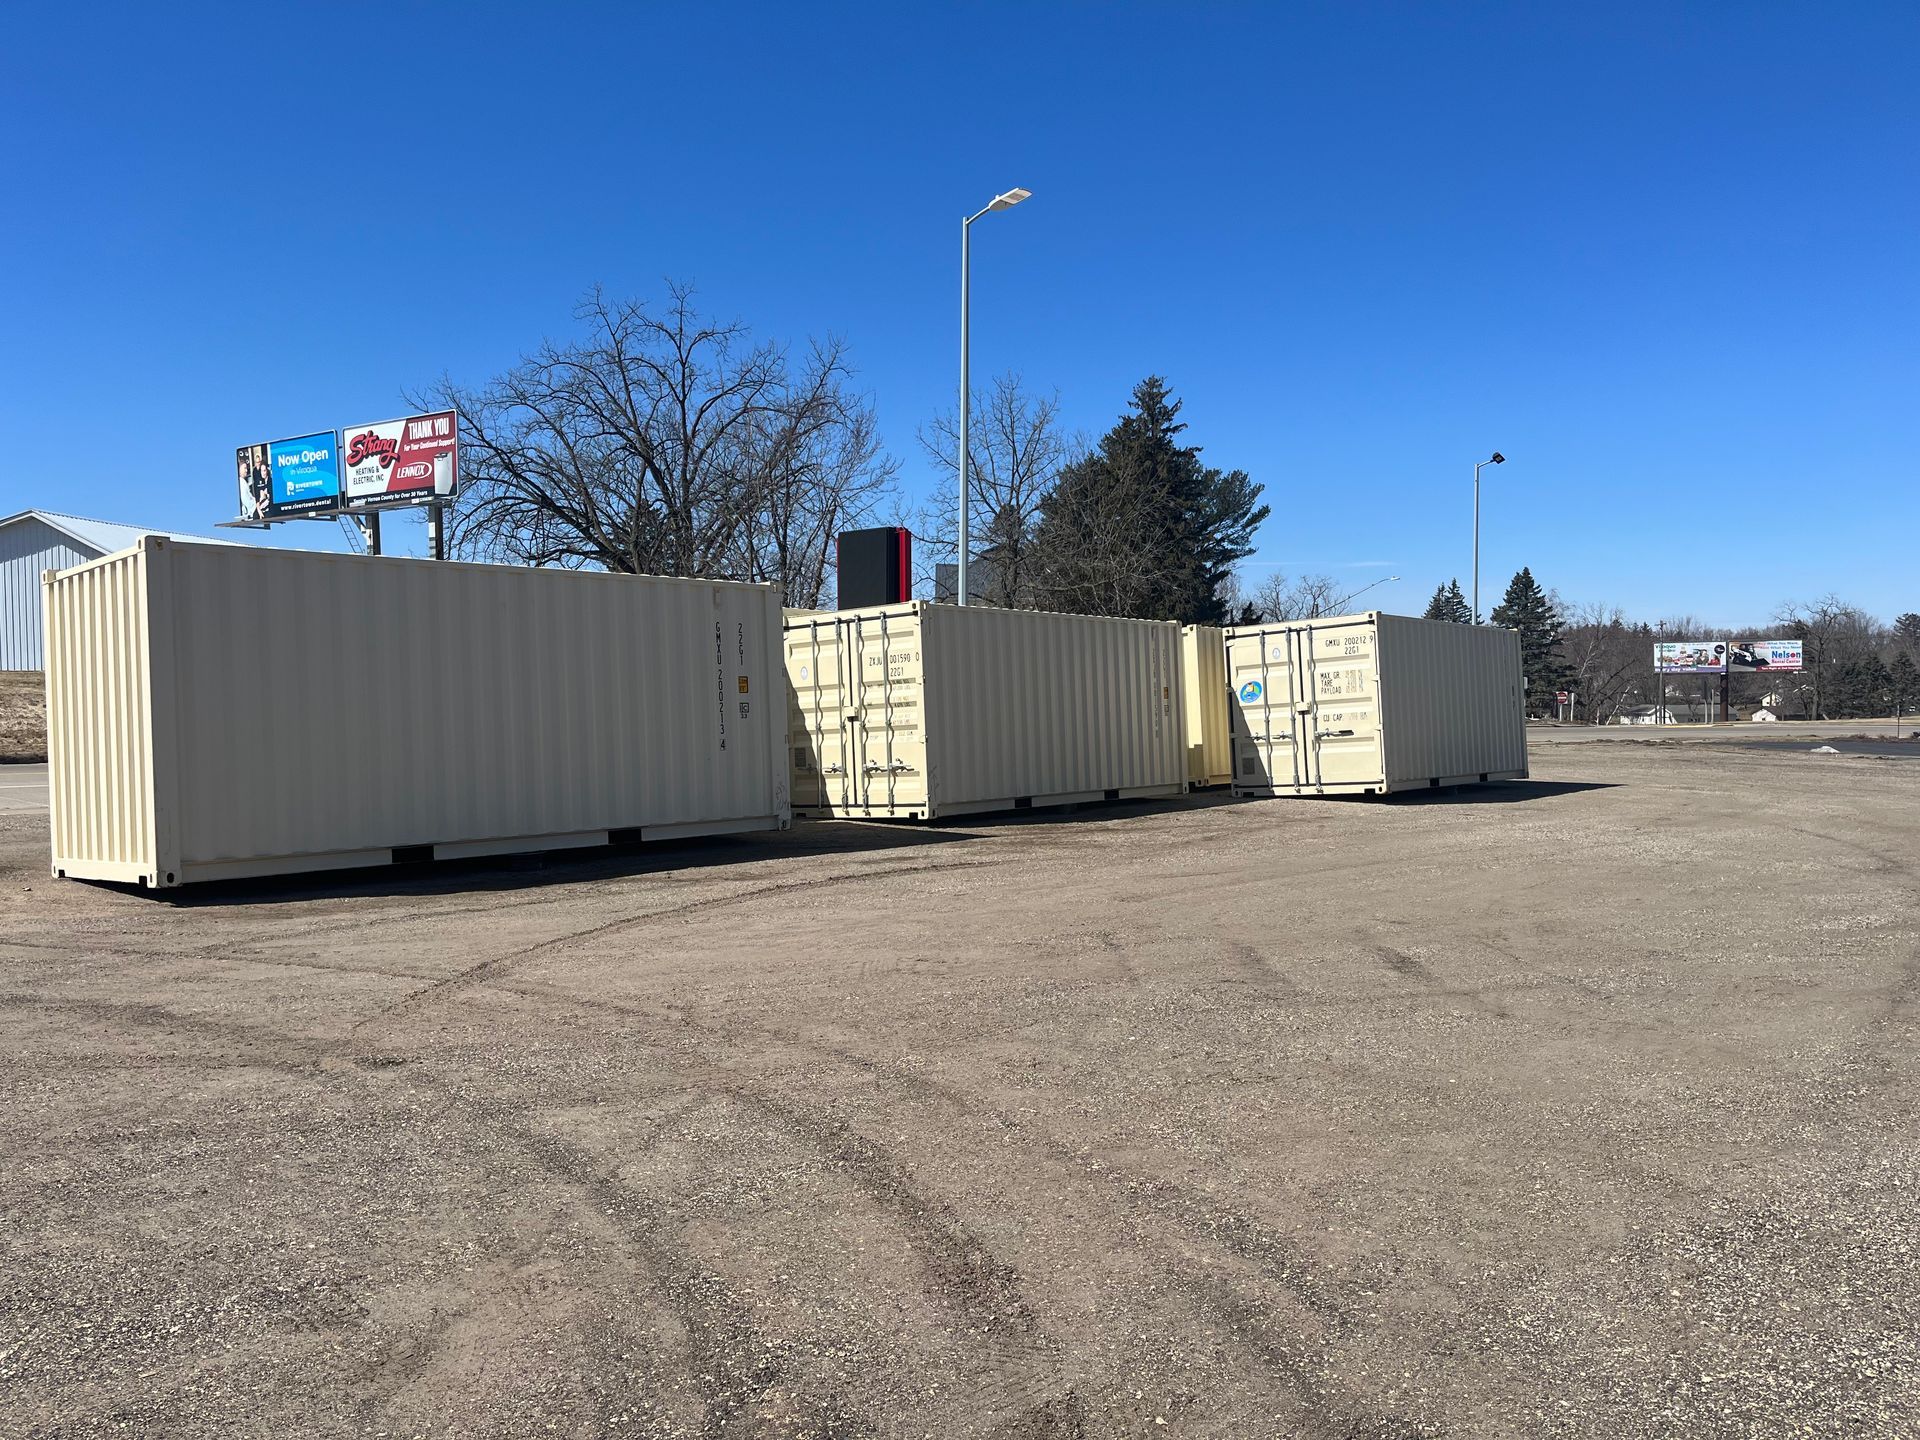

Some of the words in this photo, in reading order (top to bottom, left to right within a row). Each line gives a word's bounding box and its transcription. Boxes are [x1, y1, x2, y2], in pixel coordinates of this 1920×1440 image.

[408, 420, 433, 440] THANK
[433, 417, 450, 436] YOU
[347, 430, 400, 469] Strang
[278, 454, 300, 467] Now
[301, 449, 329, 465] Open
[355, 466, 375, 476] HEATING
[396, 464, 426, 479] LENNOX
[376, 474, 384, 482] INC
[280, 499, 332, 511] www.rivertown.dental
[1344, 636, 1367, 646] 200212
[1369, 635, 1374, 644] 9
[1771, 650, 1801, 659] Nelson
[1321, 679, 1333, 687] TARE
[717, 669, 725, 735] 200213
